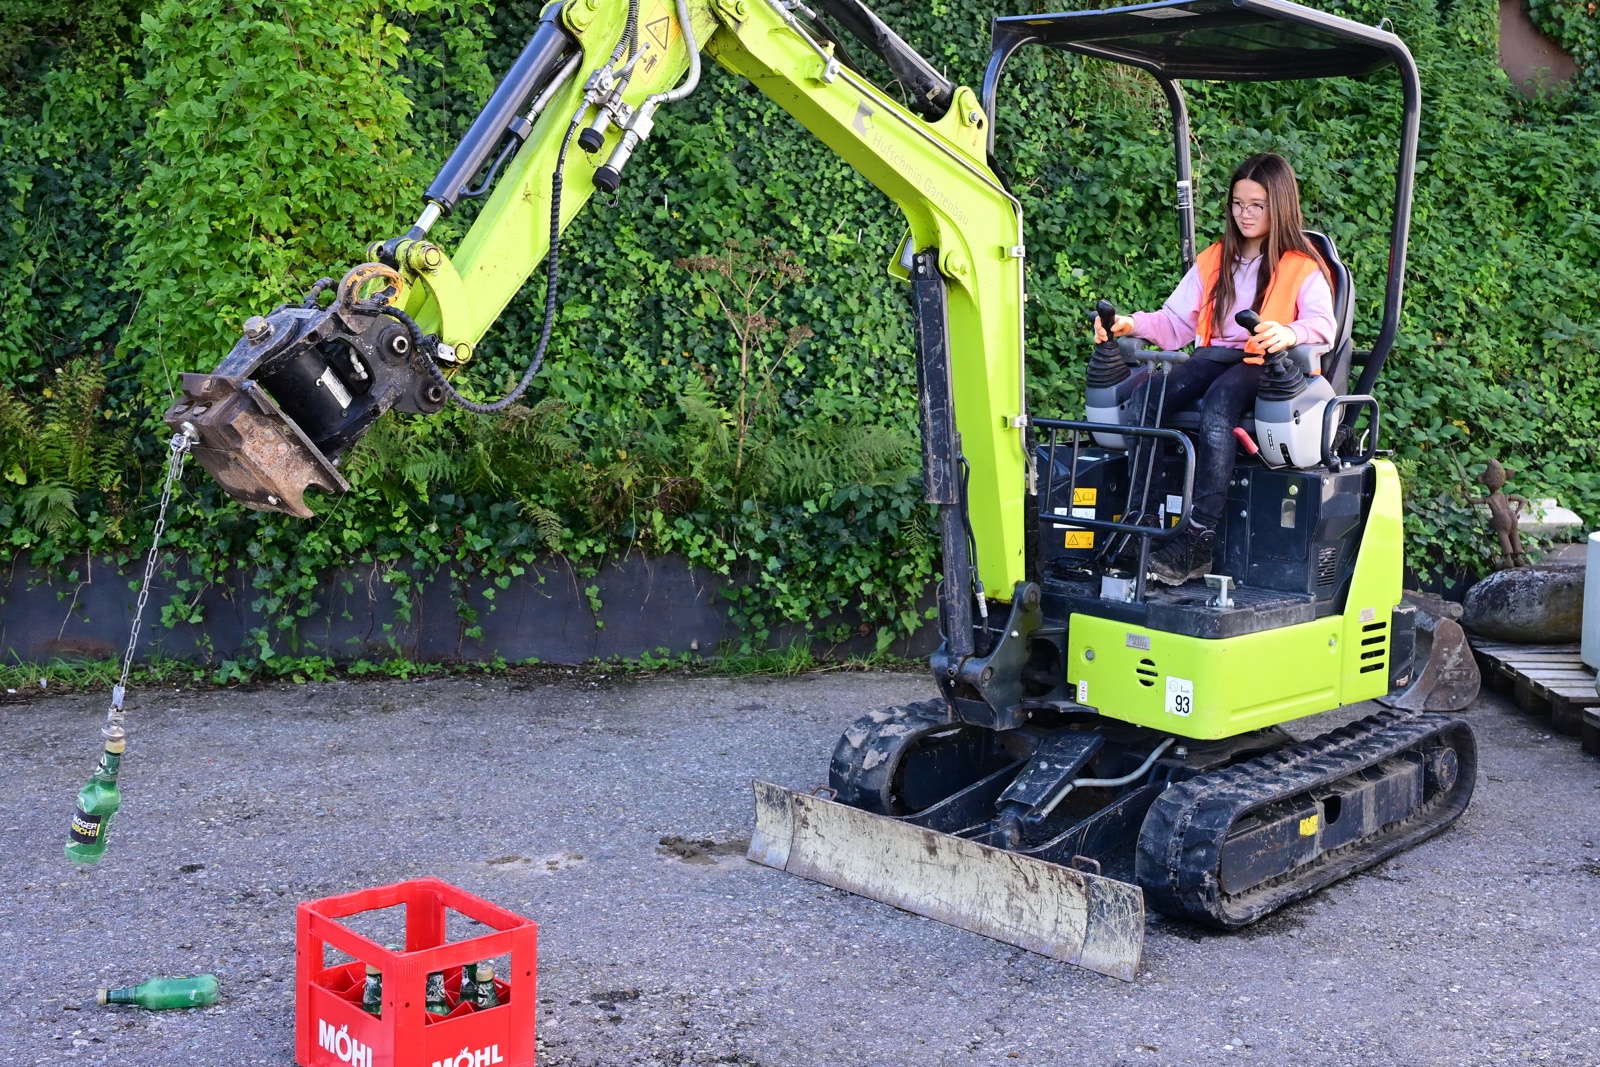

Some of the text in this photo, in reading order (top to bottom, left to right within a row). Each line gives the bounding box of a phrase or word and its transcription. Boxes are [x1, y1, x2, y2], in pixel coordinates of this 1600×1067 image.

[872, 132, 970, 226] Hufschmid Gartenbau
[1175, 694, 1190, 714] 93
